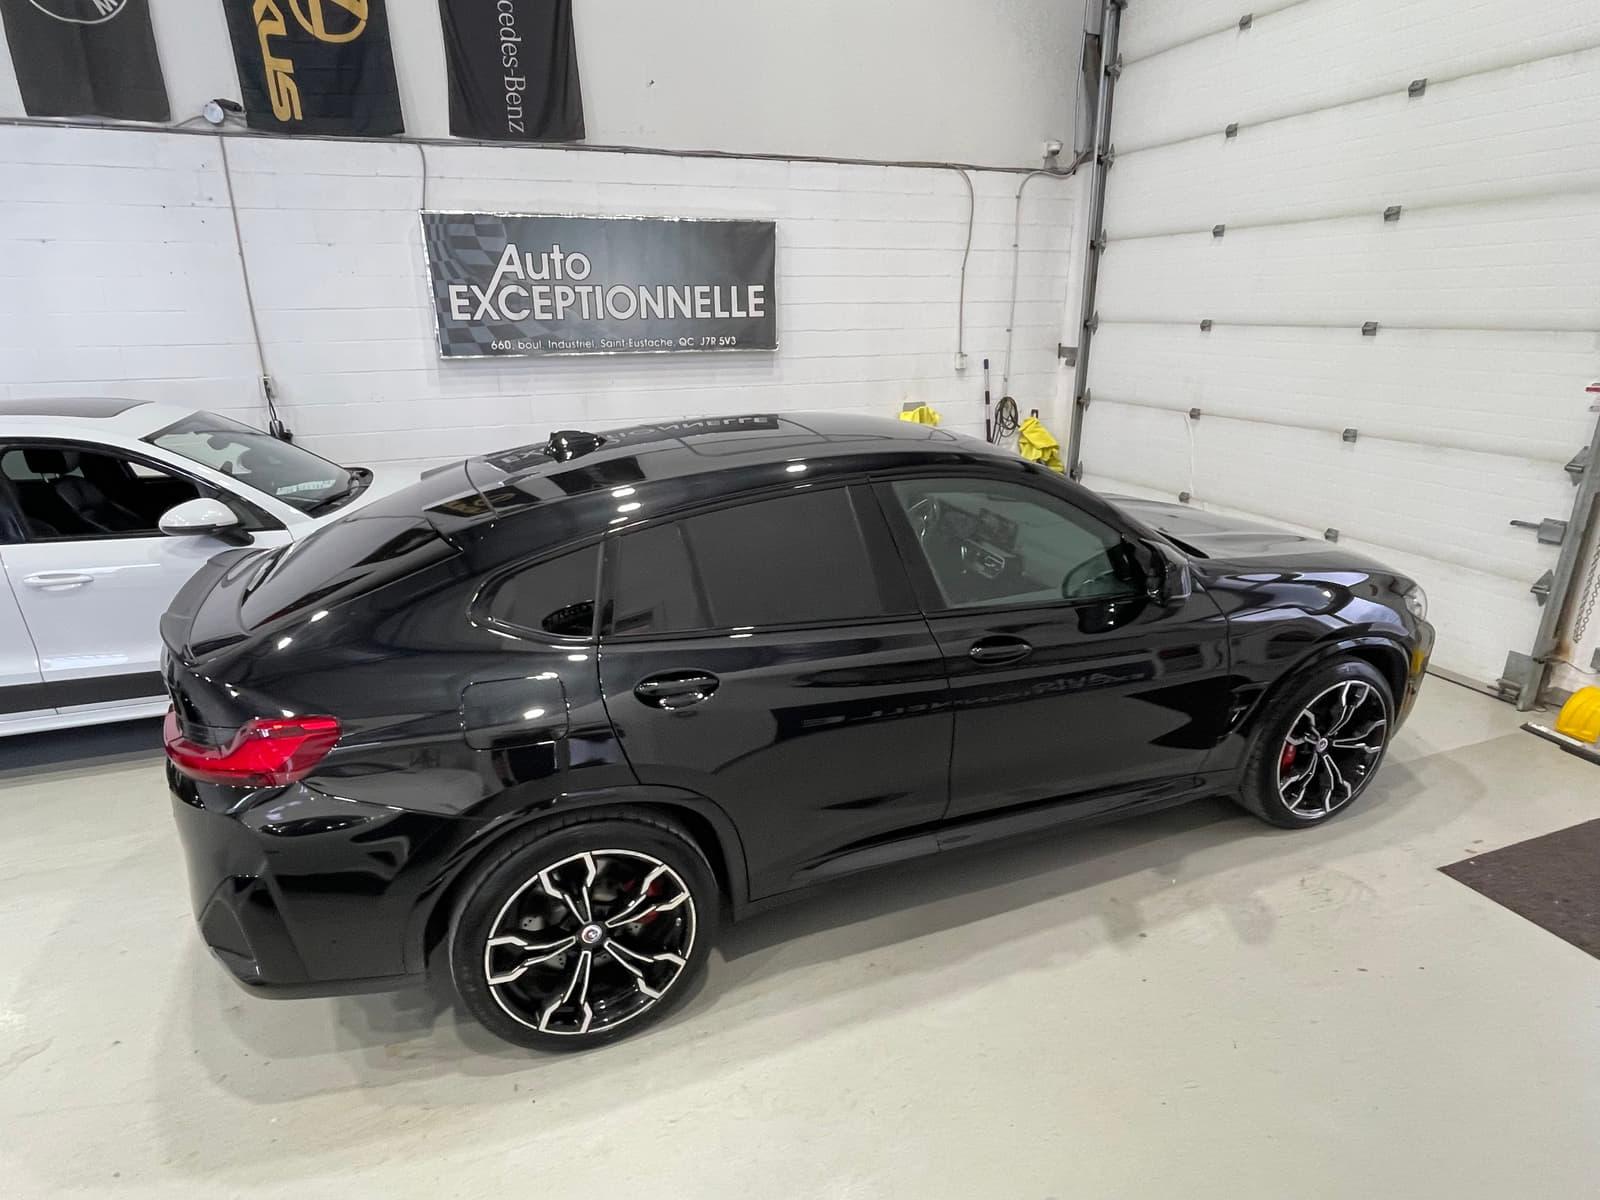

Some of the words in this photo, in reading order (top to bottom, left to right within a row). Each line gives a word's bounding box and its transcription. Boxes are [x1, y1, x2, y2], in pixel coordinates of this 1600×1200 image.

[497, 243, 591, 281] Auto
[448, 284, 765, 321] EXCEPTIONNELLE
[678, 336, 695, 347] QC
[699, 336, 717, 346] J7R
[718, 335, 737, 346] 5V3
